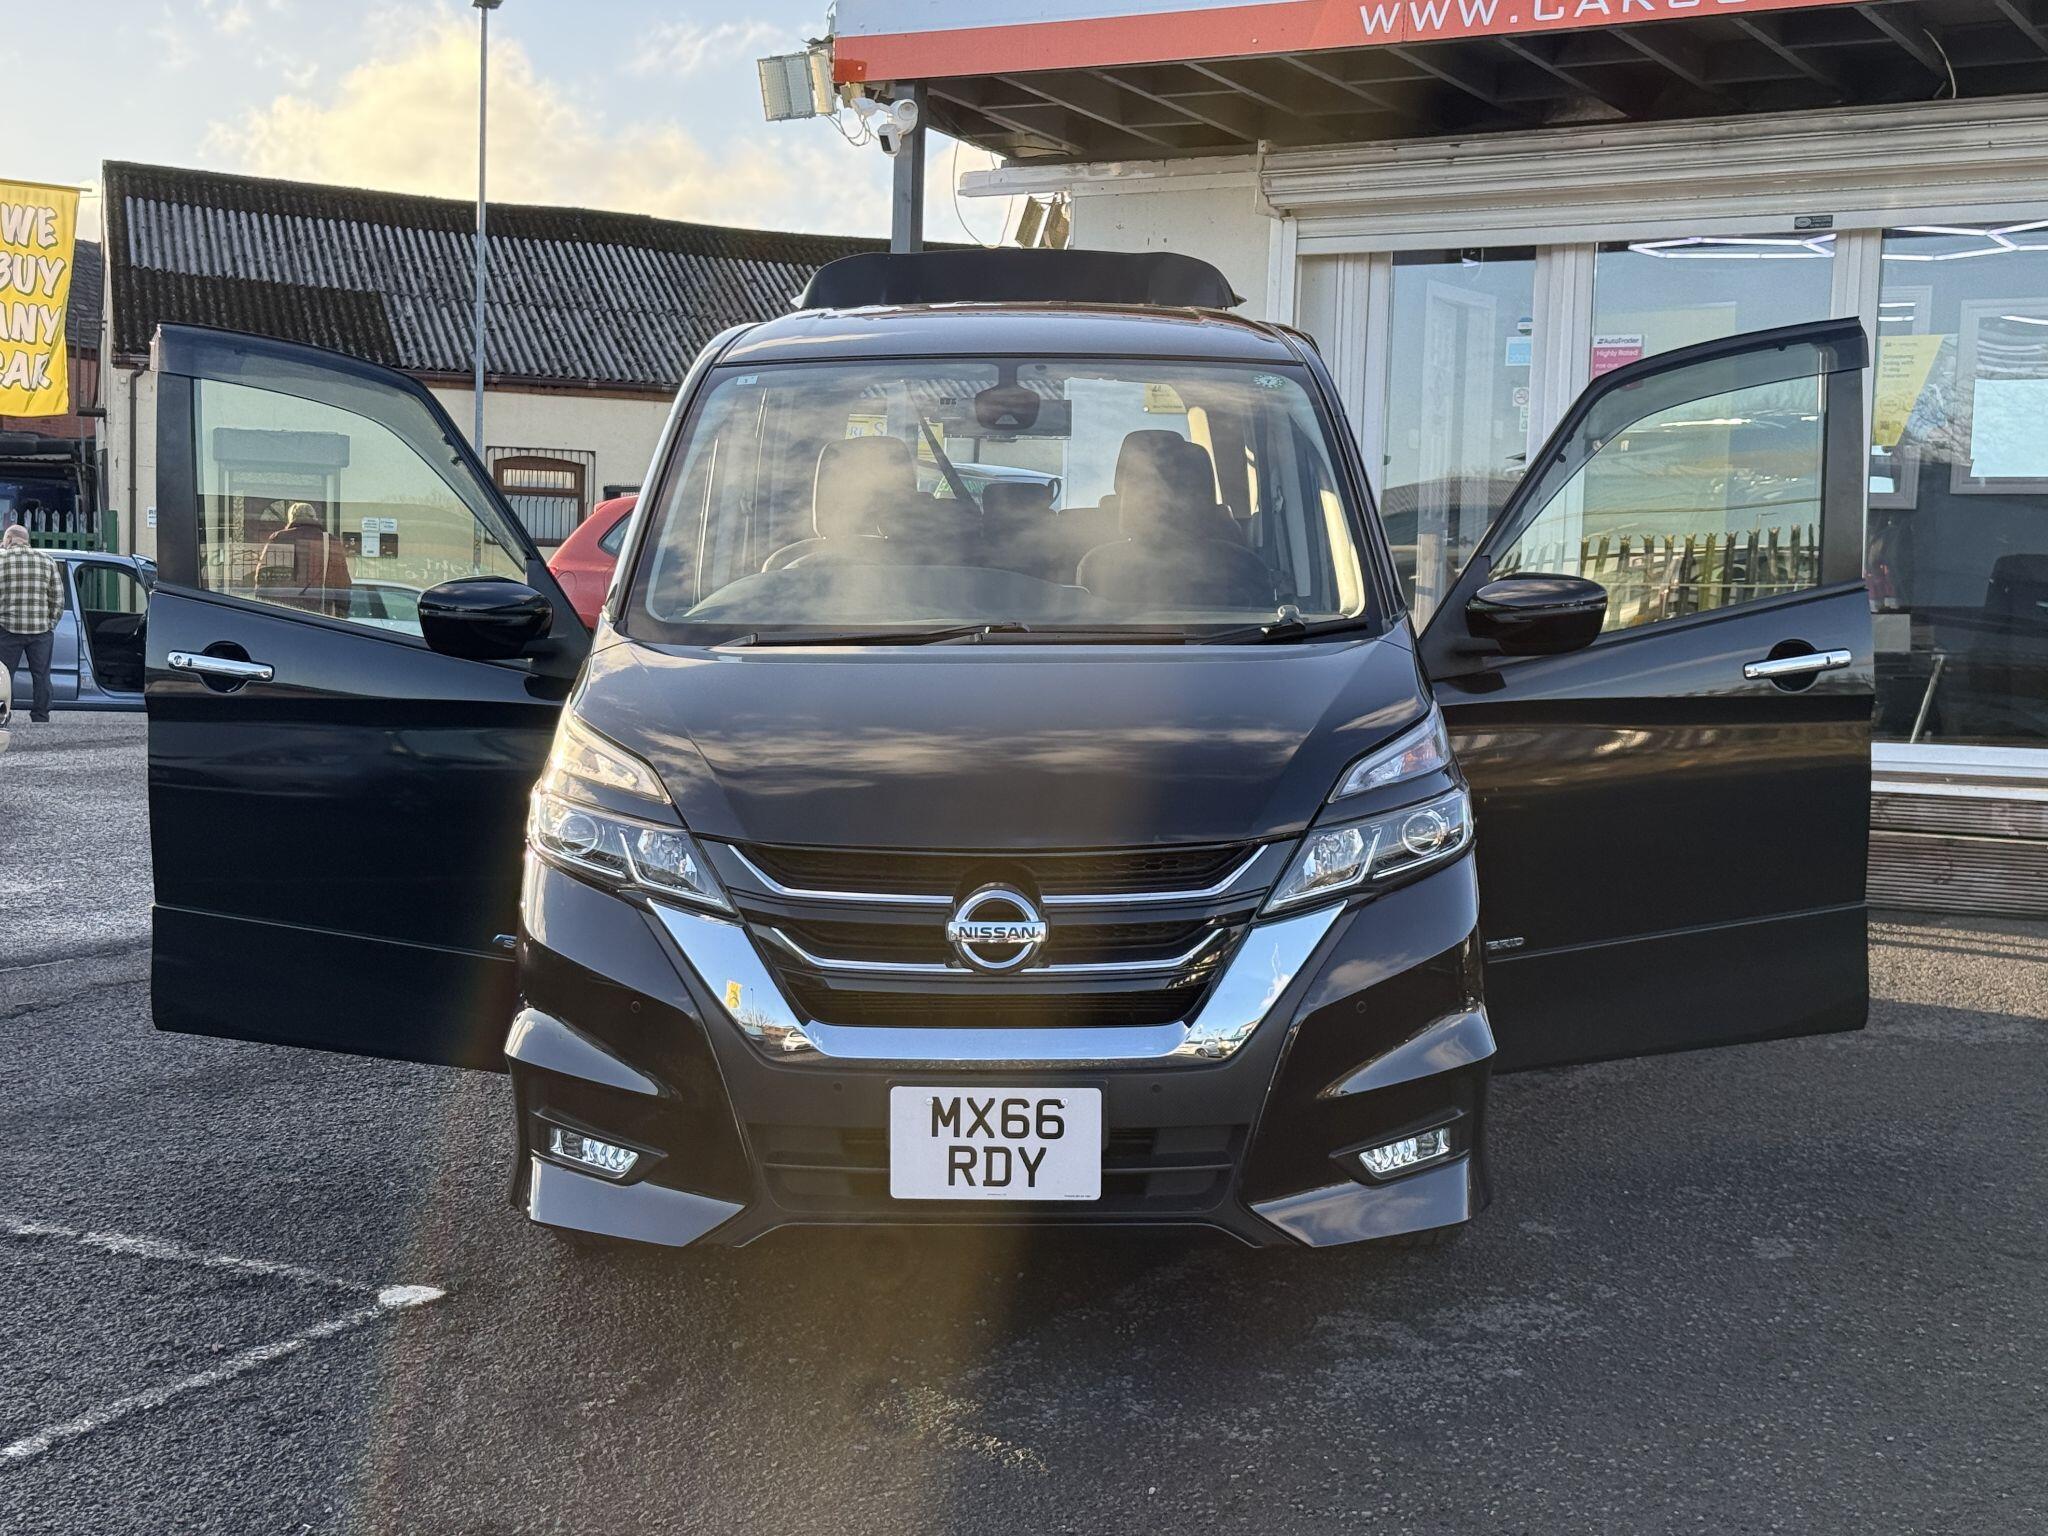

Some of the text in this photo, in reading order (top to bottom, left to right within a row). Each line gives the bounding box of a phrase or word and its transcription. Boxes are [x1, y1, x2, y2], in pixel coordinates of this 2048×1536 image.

[1359, 0, 1746, 35] WWW.CA
[0, 202, 58, 250] WE
[0, 349, 52, 391] AR
[958, 926, 1036, 939] NISSAN
[931, 1096, 1066, 1140] MX66
[947, 1145, 1047, 1188] RDY
